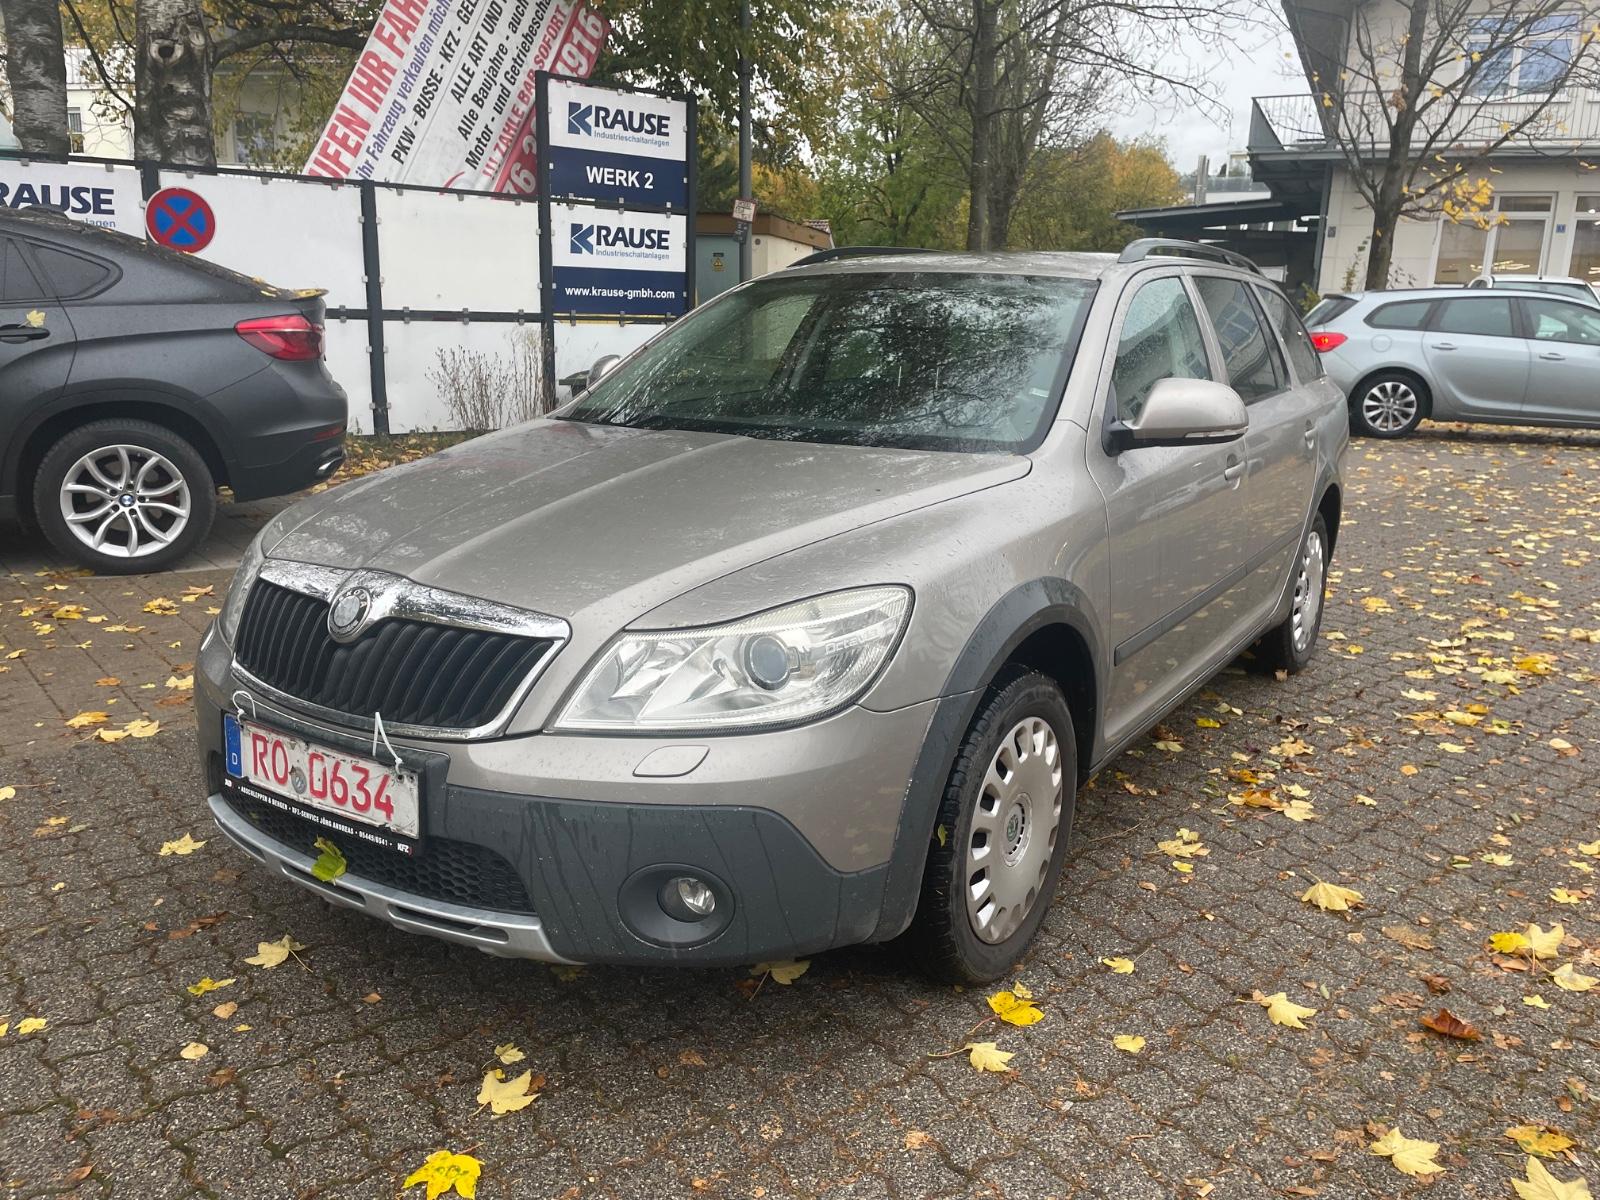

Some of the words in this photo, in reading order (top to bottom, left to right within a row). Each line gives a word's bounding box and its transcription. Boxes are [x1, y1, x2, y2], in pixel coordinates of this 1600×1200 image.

[427, 0, 453, 36] möch
[346, 49, 398, 114] IHR
[373, 0, 429, 60] FAH
[396, 33, 434, 101] verkaufen
[450, 62, 476, 105] ALLE
[467, 31, 489, 68] ART
[481, 0, 504, 35] UND
[390, 125, 417, 166] PKW
[412, 68, 444, 120] BUSSE
[438, 29, 461, 64] KFZ
[457, 107, 480, 142] Alle
[471, 42, 509, 110] Baujahre
[493, 103, 526, 159] ZAHLE
[533, 4, 568, 70] SOFORT
[365, 98, 407, 162] Fahrzeug
[464, 123, 494, 171] Motor
[492, 82, 512, 116] und
[568, 101, 672, 138] KRAUSE
[594, 130, 670, 148] Industrieschaltanlagen
[355, 159, 376, 180] ihr
[585, 165, 641, 189] WERK
[643, 171, 655, 190] 2
[570, 222, 671, 256] KRAUSE
[595, 248, 671, 261] Industrieschaltanlagen
[564, 285, 676, 300] www.krause-gmbh.com
[231, 752, 238, 765] D
[251, 732, 290, 786] RO
